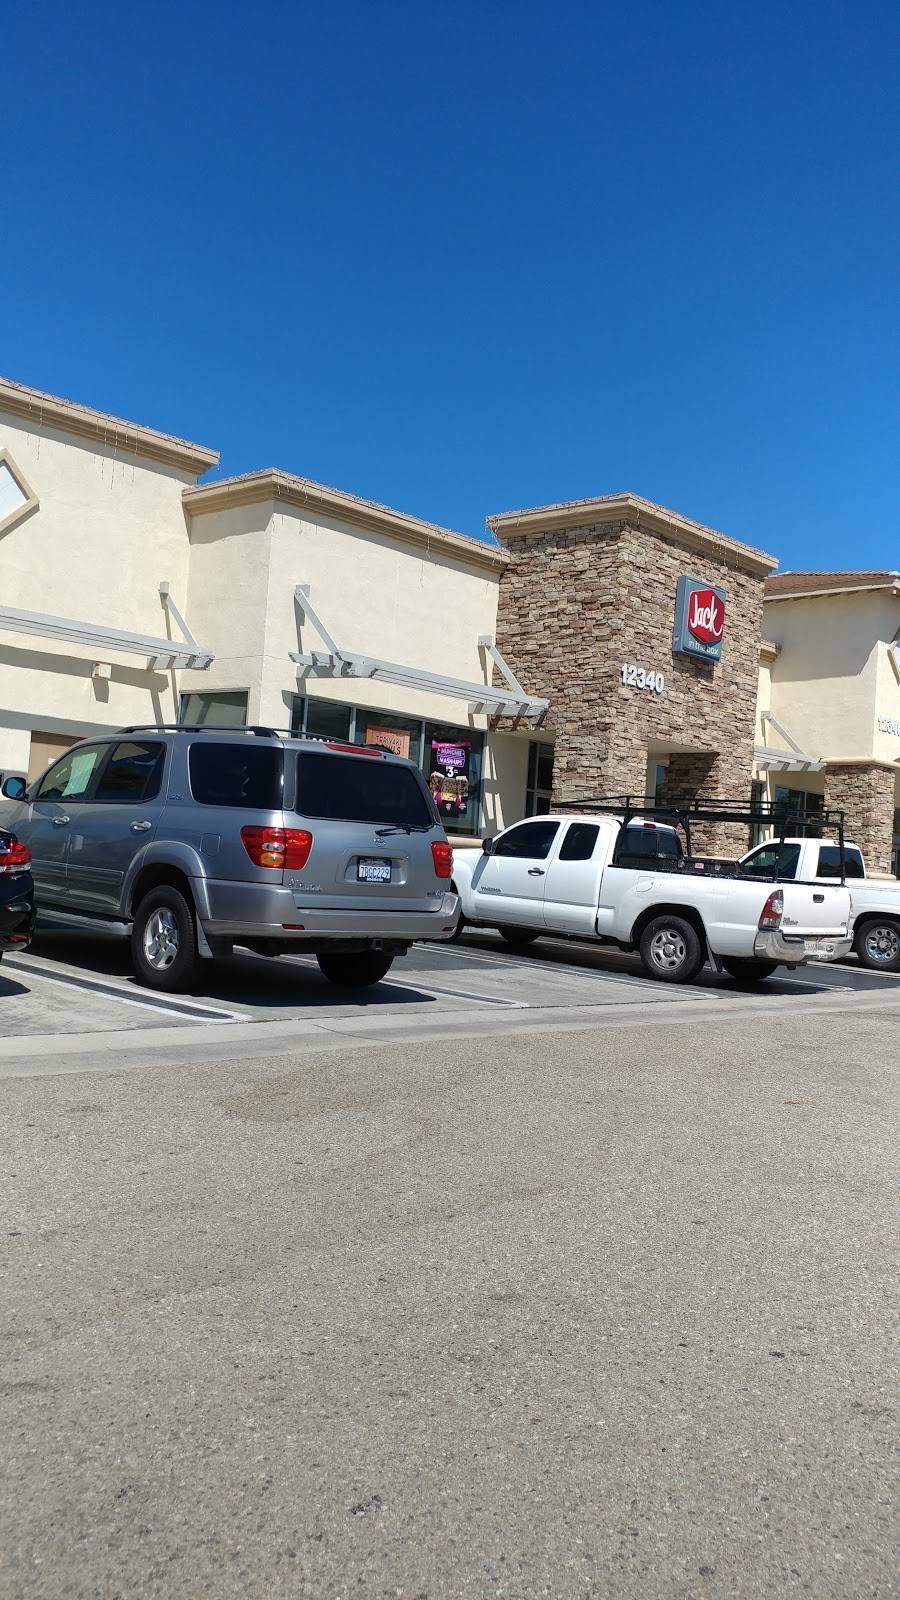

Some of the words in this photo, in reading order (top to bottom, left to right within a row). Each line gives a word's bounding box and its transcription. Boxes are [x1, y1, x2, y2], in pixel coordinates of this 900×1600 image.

[689, 594, 723, 637] Jack
[688, 639, 695, 648] in
[694, 641, 705, 652] the
[705, 644, 719, 655] box
[620, 663, 665, 694] 12340
[376, 735, 402, 746] TERIYAKI
